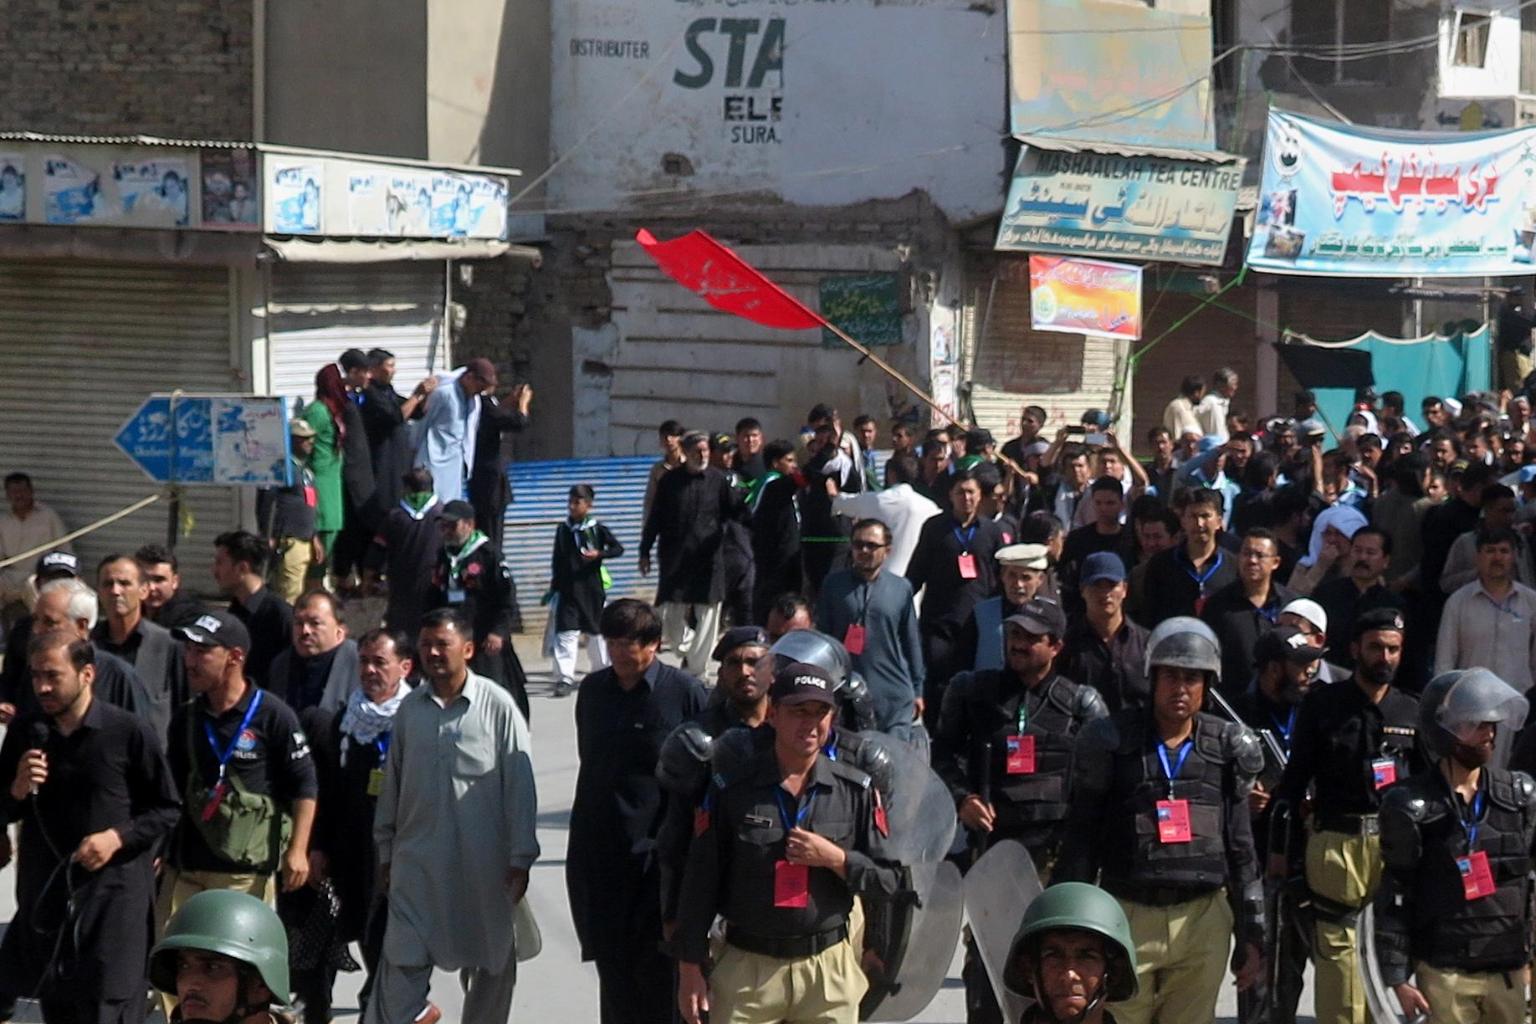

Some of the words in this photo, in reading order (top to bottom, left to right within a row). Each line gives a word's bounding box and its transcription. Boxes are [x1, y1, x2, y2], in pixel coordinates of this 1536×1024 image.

[569, 39, 651, 60] DISTRIBUTER
[1148, 162, 1176, 185] TEA
[1180, 167, 1241, 192] CENTRE
[794, 676, 827, 689] POLICE
